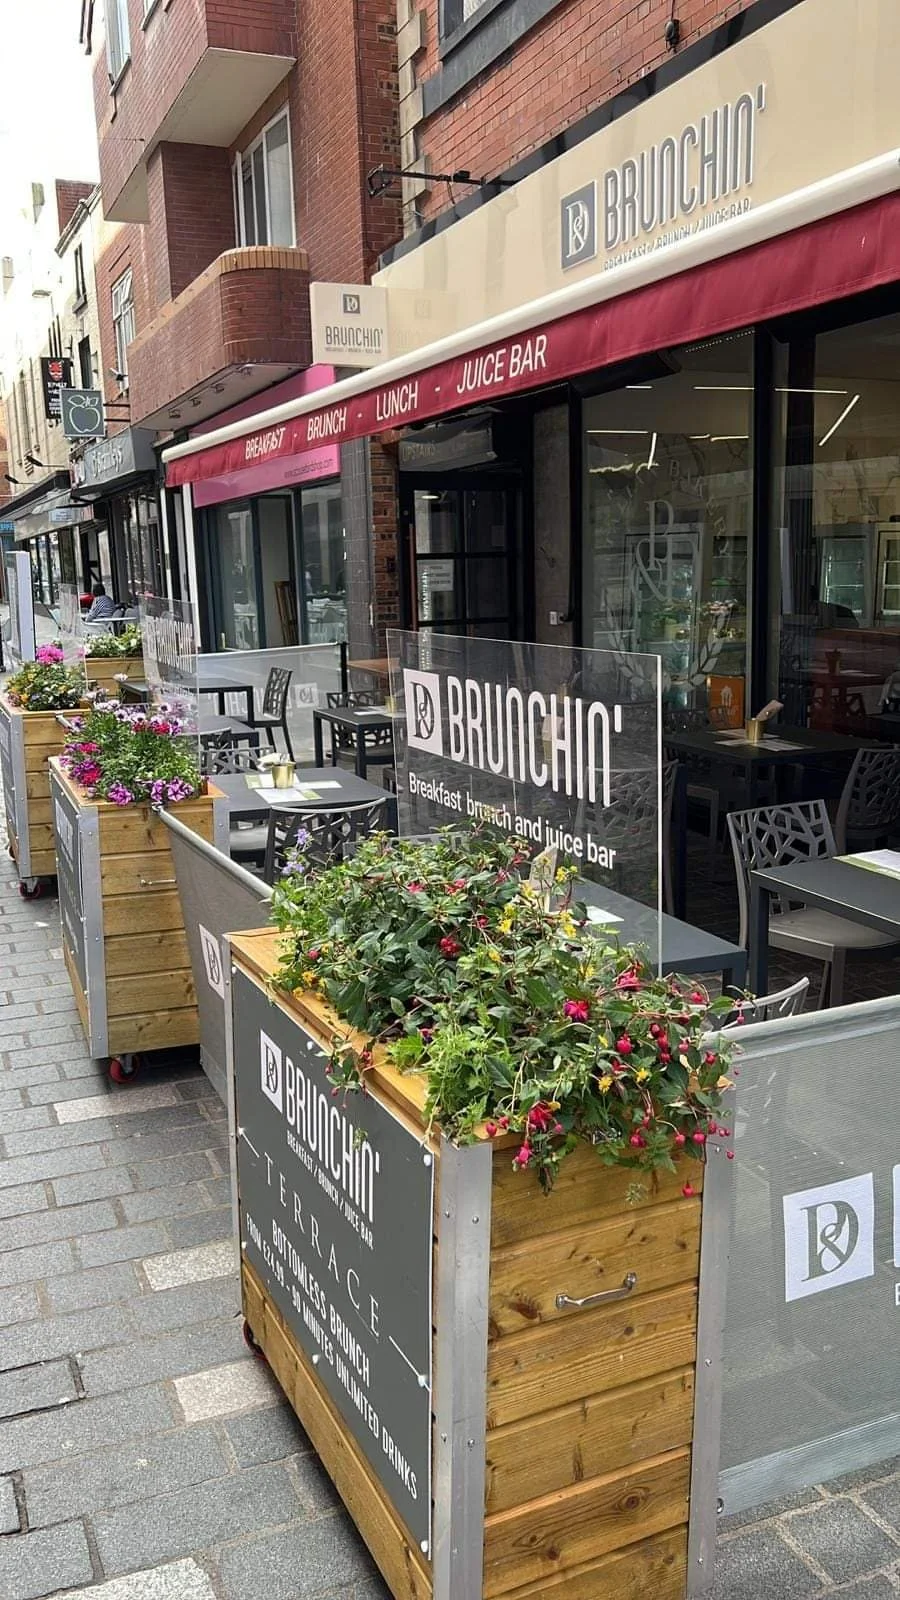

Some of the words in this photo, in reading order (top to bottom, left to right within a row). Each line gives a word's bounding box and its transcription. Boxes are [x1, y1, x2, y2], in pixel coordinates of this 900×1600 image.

[604, 82, 767, 252] BRUNCHIN'
[307, 407, 347, 442] BRUNCH
[376, 381, 419, 422] LUNCH
[456, 347, 507, 394] JUICE
[509, 334, 548, 379] BAR
[325, 325, 384, 348] BRUNCHIN'
[447, 675, 622, 809] BRUNCHIN'
[409, 771, 463, 812] Breakfast
[466, 791, 512, 832] brunch
[515, 814, 543, 843] and
[545, 820, 584, 858] juice
[587, 833, 617, 870] bar
[286, 1056, 381, 1223] BRUNCHIN'
[287, 1129, 314, 1173] BREAKFAST
[318, 1167, 339, 1206] BRUNCH
[345, 1201, 360, 1232] JUICE
[361, 1220, 374, 1250] BAR
[264, 1151, 380, 1338] TERRACE
[272, 1218, 327, 1320] BOTTOMLESS
[330, 1303, 371, 1388] BRUNCH
[246, 1212, 262, 1252] FROM
[263, 1239, 284, 1288] £24.99
[292, 1284, 301, 1313] 90
[302, 1300, 335, 1366] MINUTES
[336, 1356, 380, 1439] UNLIMITED
[382, 1426, 418, 1500] DRINKS
